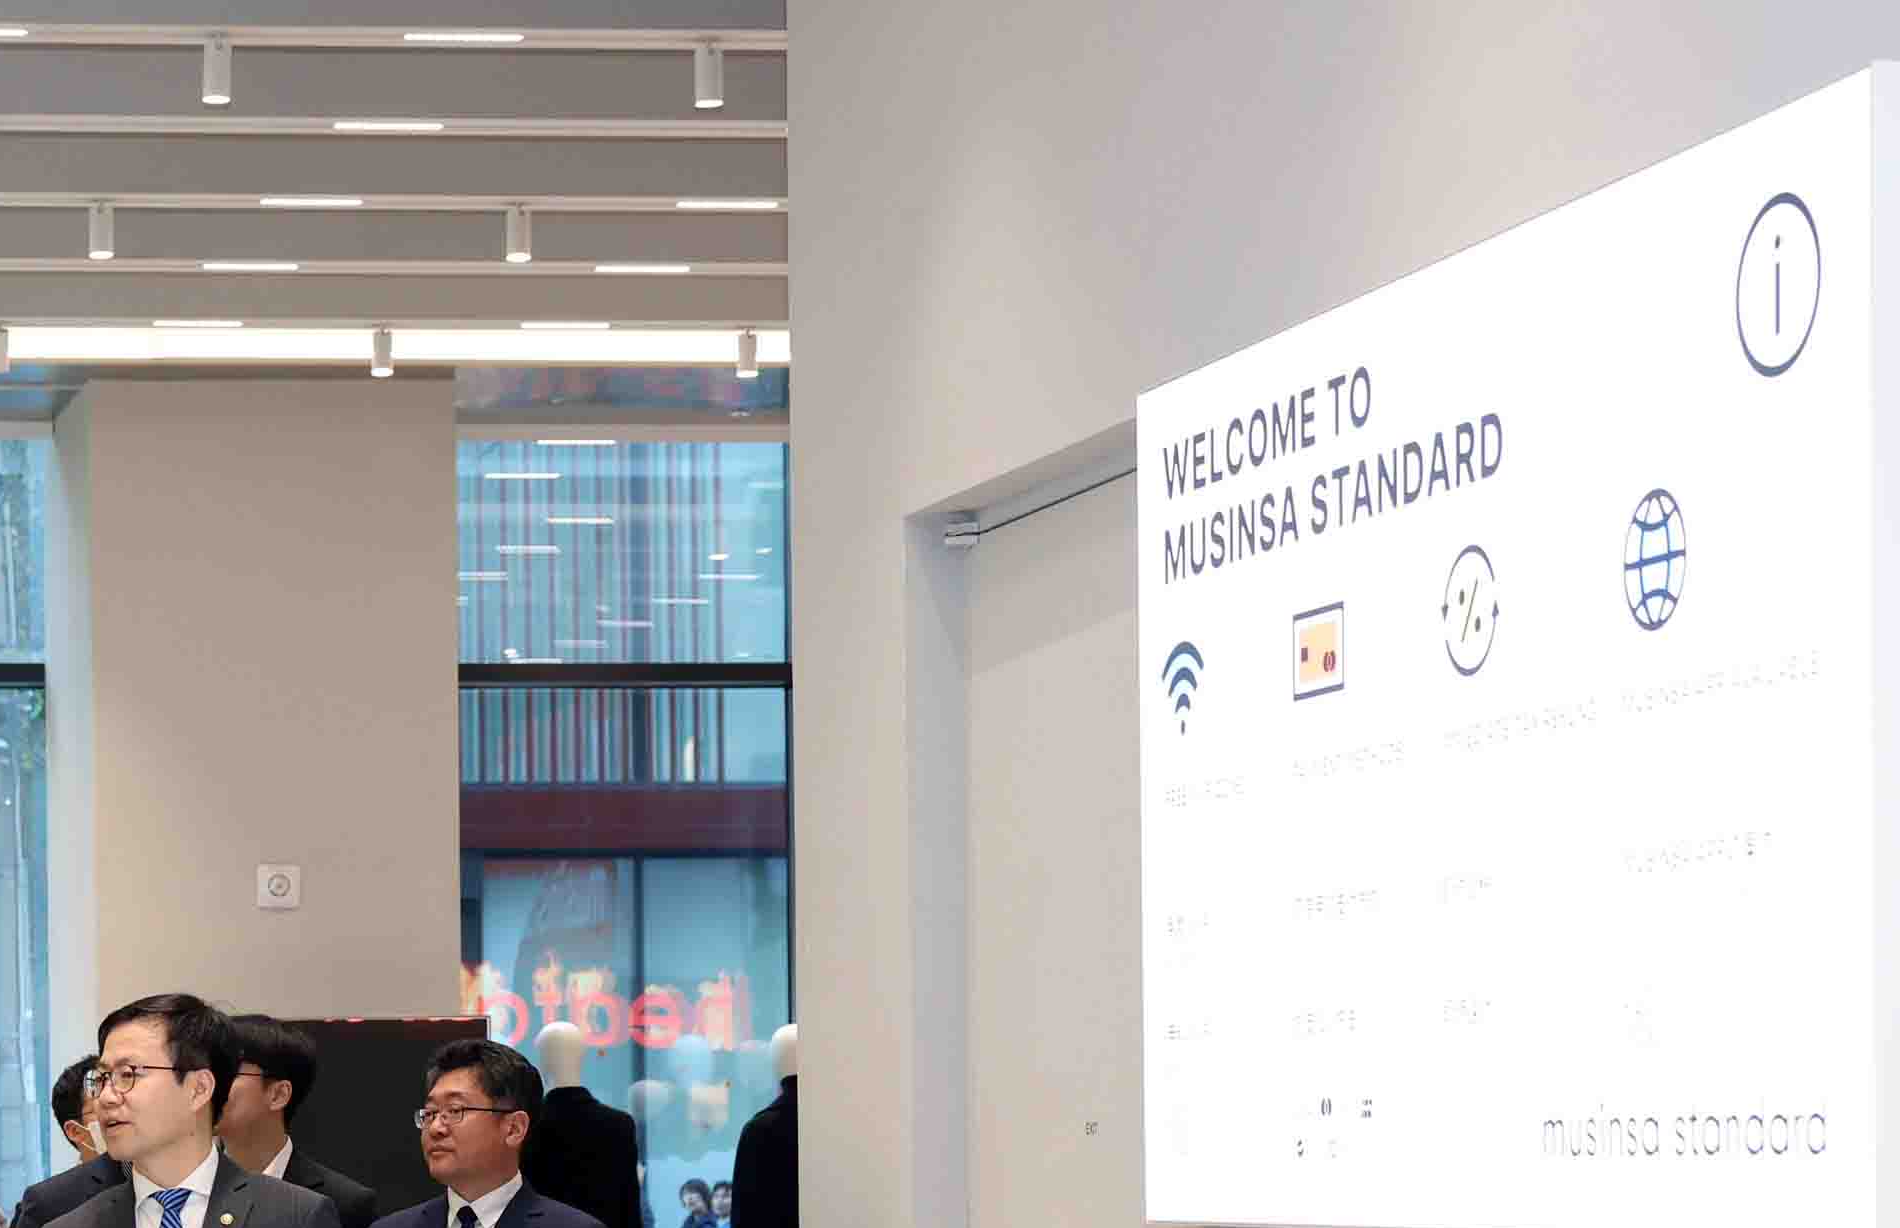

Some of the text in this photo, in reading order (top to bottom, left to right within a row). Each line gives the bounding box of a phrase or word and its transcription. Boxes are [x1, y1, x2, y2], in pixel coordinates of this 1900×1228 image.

[1164, 366, 1371, 499] WELCOME TO
[1165, 413, 1502, 584] MUSINSA STANDARD
[1543, 1103, 1659, 1156] musinsa
